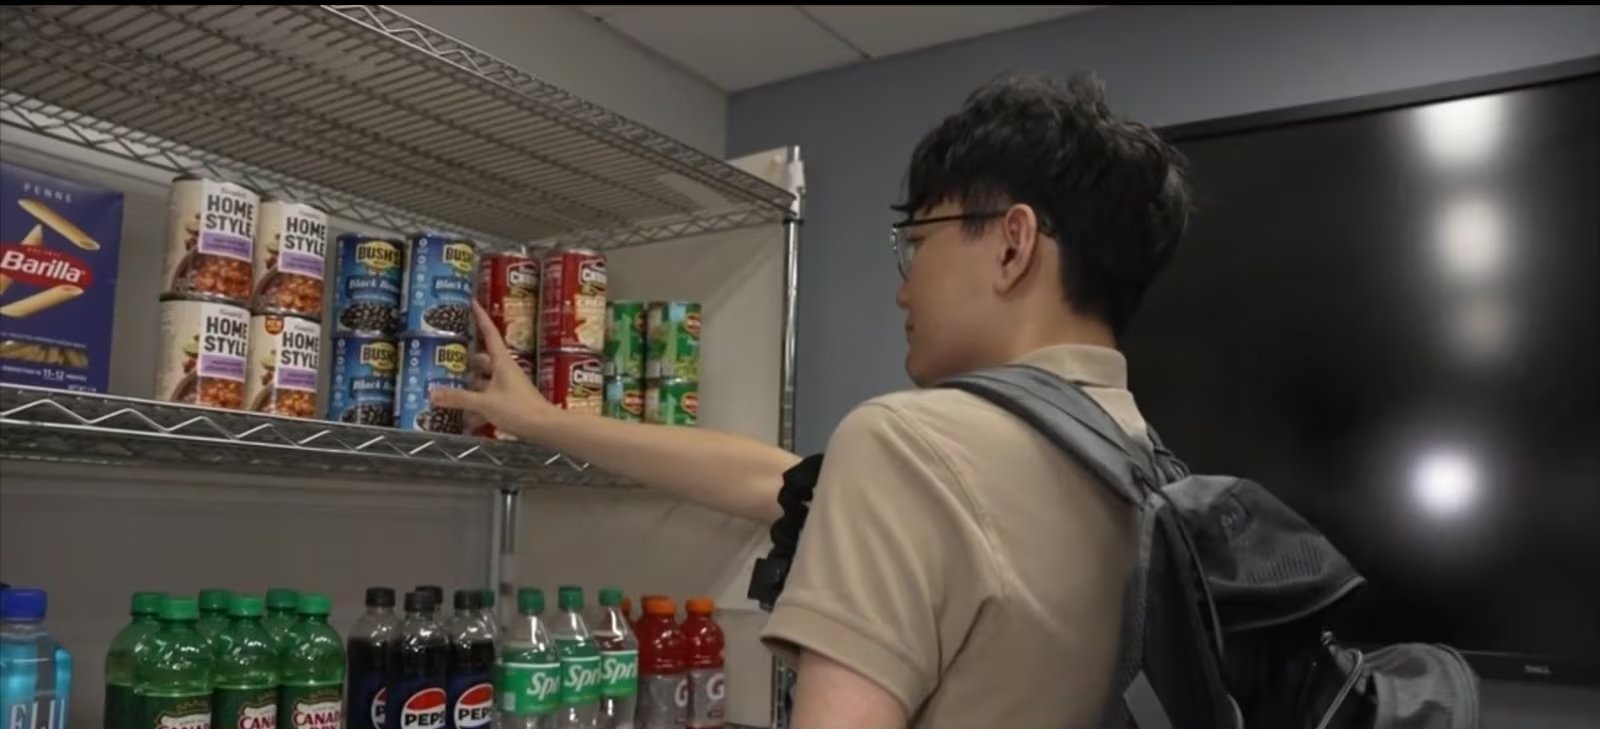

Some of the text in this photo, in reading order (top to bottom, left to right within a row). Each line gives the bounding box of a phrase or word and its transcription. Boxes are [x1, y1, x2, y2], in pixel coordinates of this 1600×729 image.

[23, 182, 73, 204] PENNE
[207, 194, 254, 221] HOME
[205, 214, 253, 239] STYLE
[286, 216, 327, 241] HOME
[284, 235, 325, 257] STYLE
[1, 250, 82, 284] Barilla
[206, 316, 249, 340] HOME
[204, 335, 247, 357] STYLE
[282, 331, 320, 353] HOME
[280, 350, 319, 369] STYLE
[706, 673, 725, 701] G
